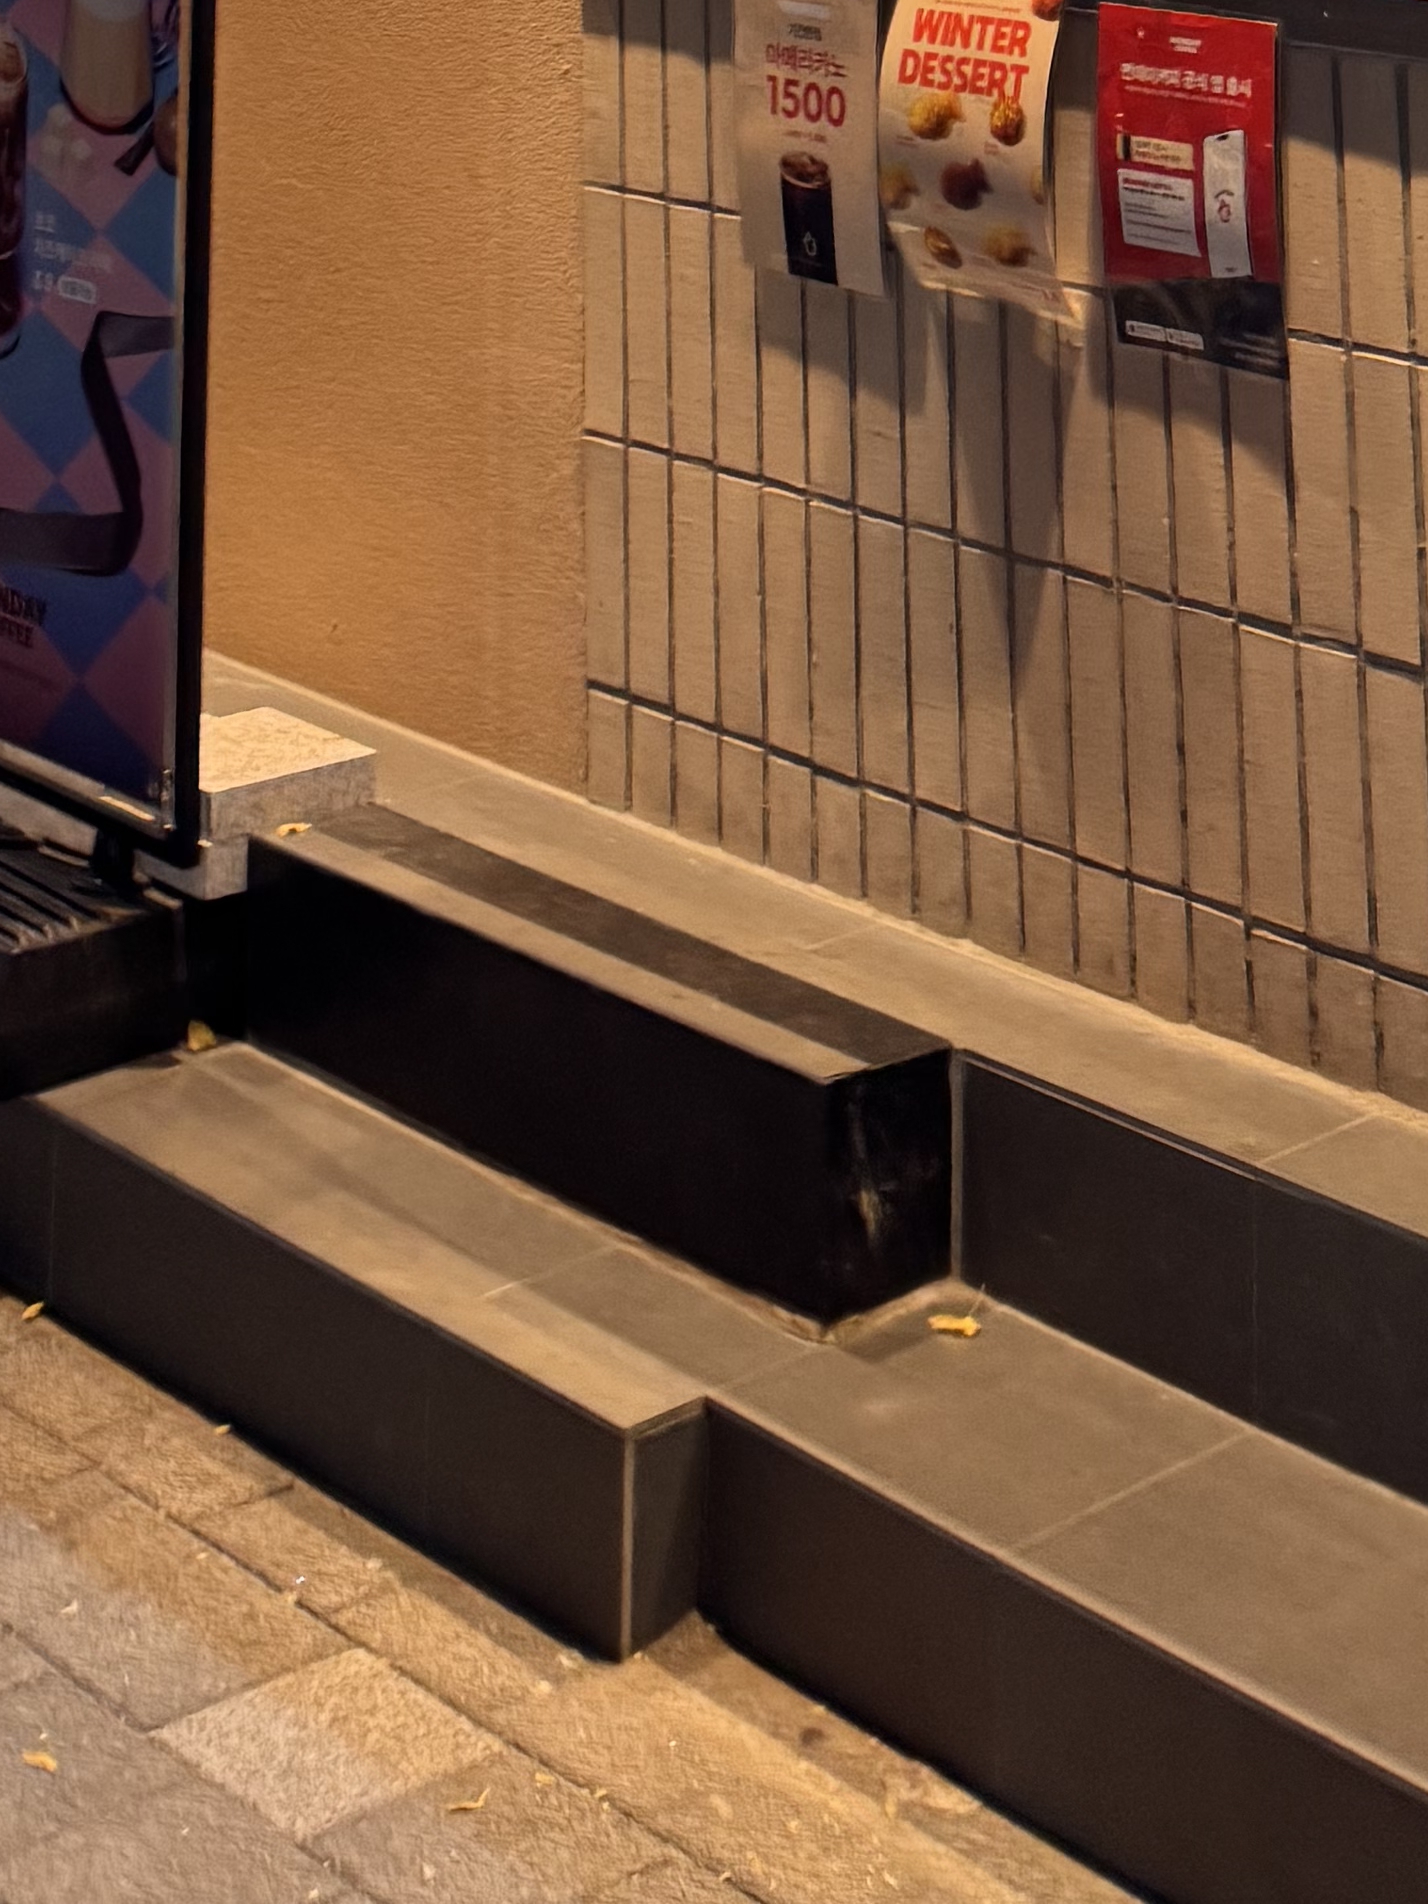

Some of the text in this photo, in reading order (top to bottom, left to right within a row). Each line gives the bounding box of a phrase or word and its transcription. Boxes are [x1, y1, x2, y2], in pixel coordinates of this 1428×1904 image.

[912, 7, 1033, 59] WINTER
[766, 74, 847, 128] 1500
[897, 48, 1030, 105] DESSERT
